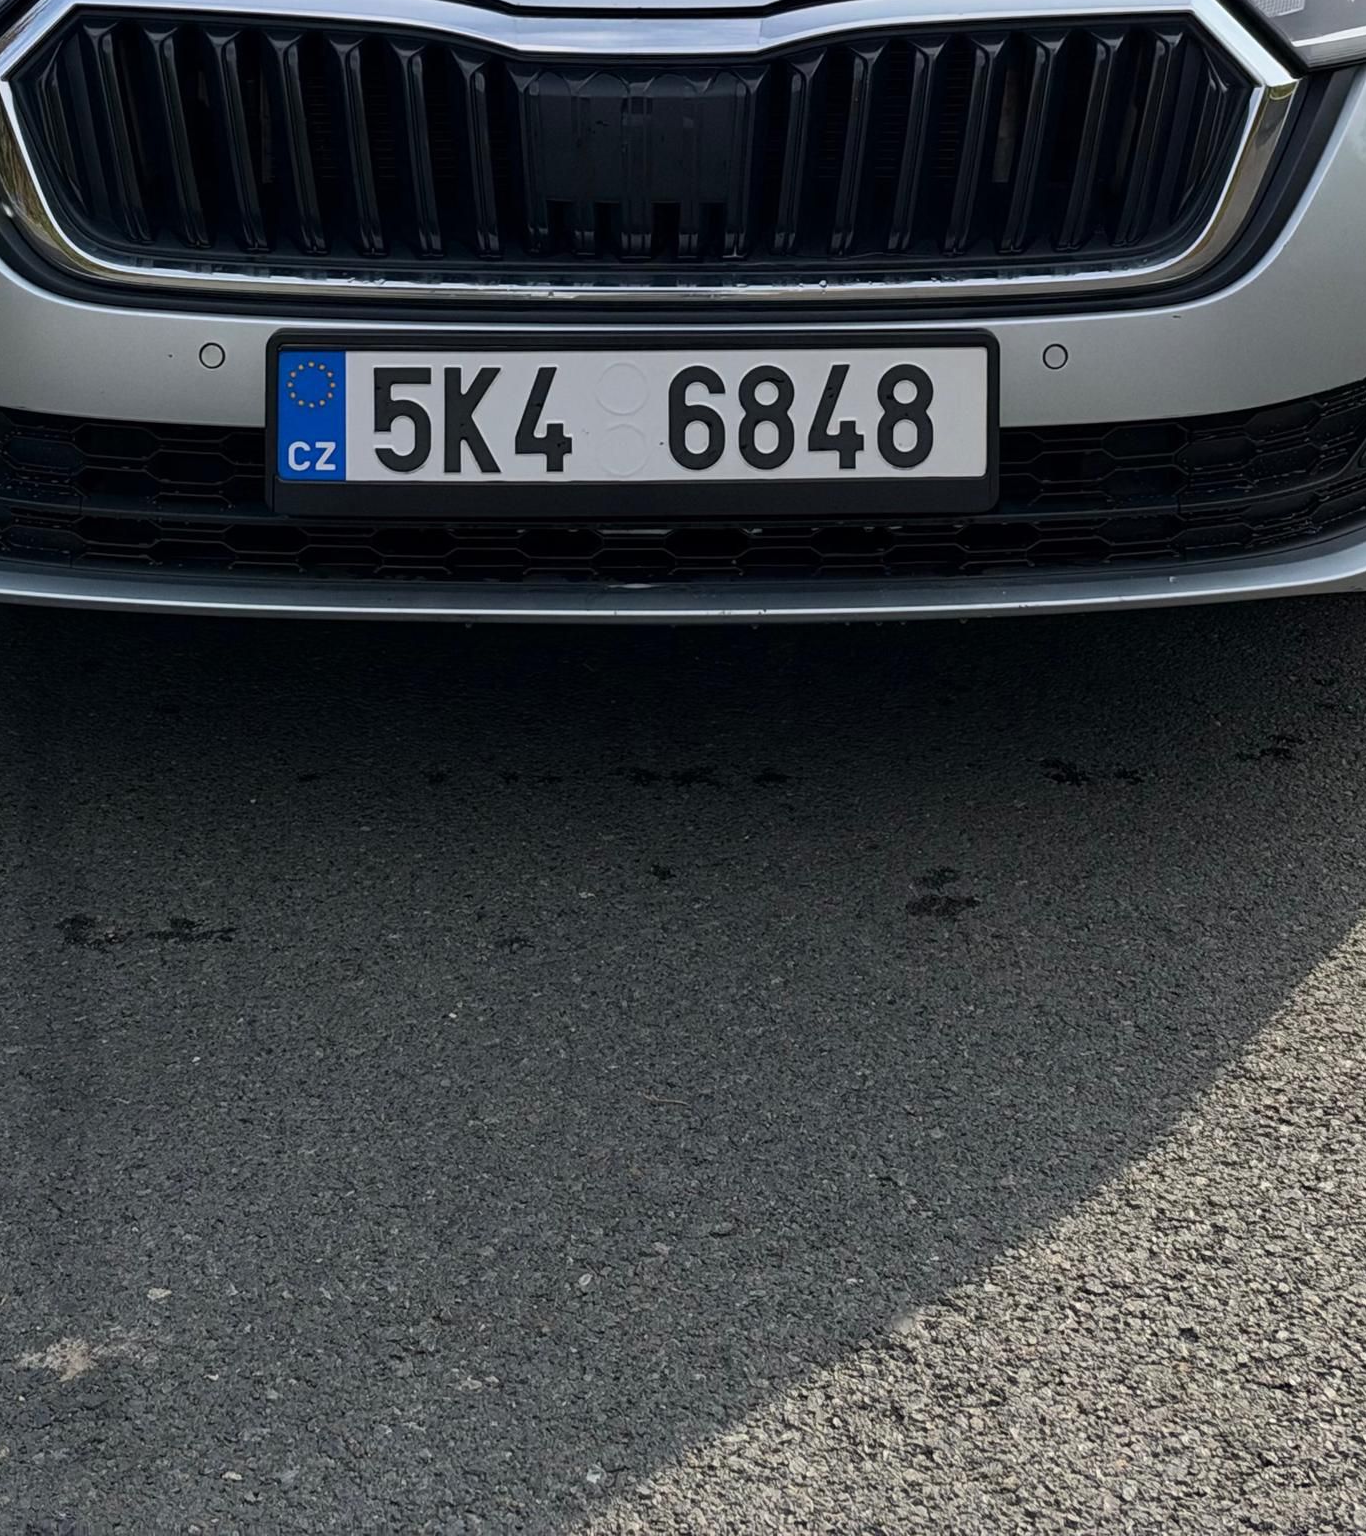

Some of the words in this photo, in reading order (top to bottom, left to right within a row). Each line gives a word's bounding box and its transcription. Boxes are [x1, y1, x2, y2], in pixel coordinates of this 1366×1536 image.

[372, 366, 573, 474] 5K4
[668, 363, 934, 471] 6848
[288, 440, 337, 472] CZ
